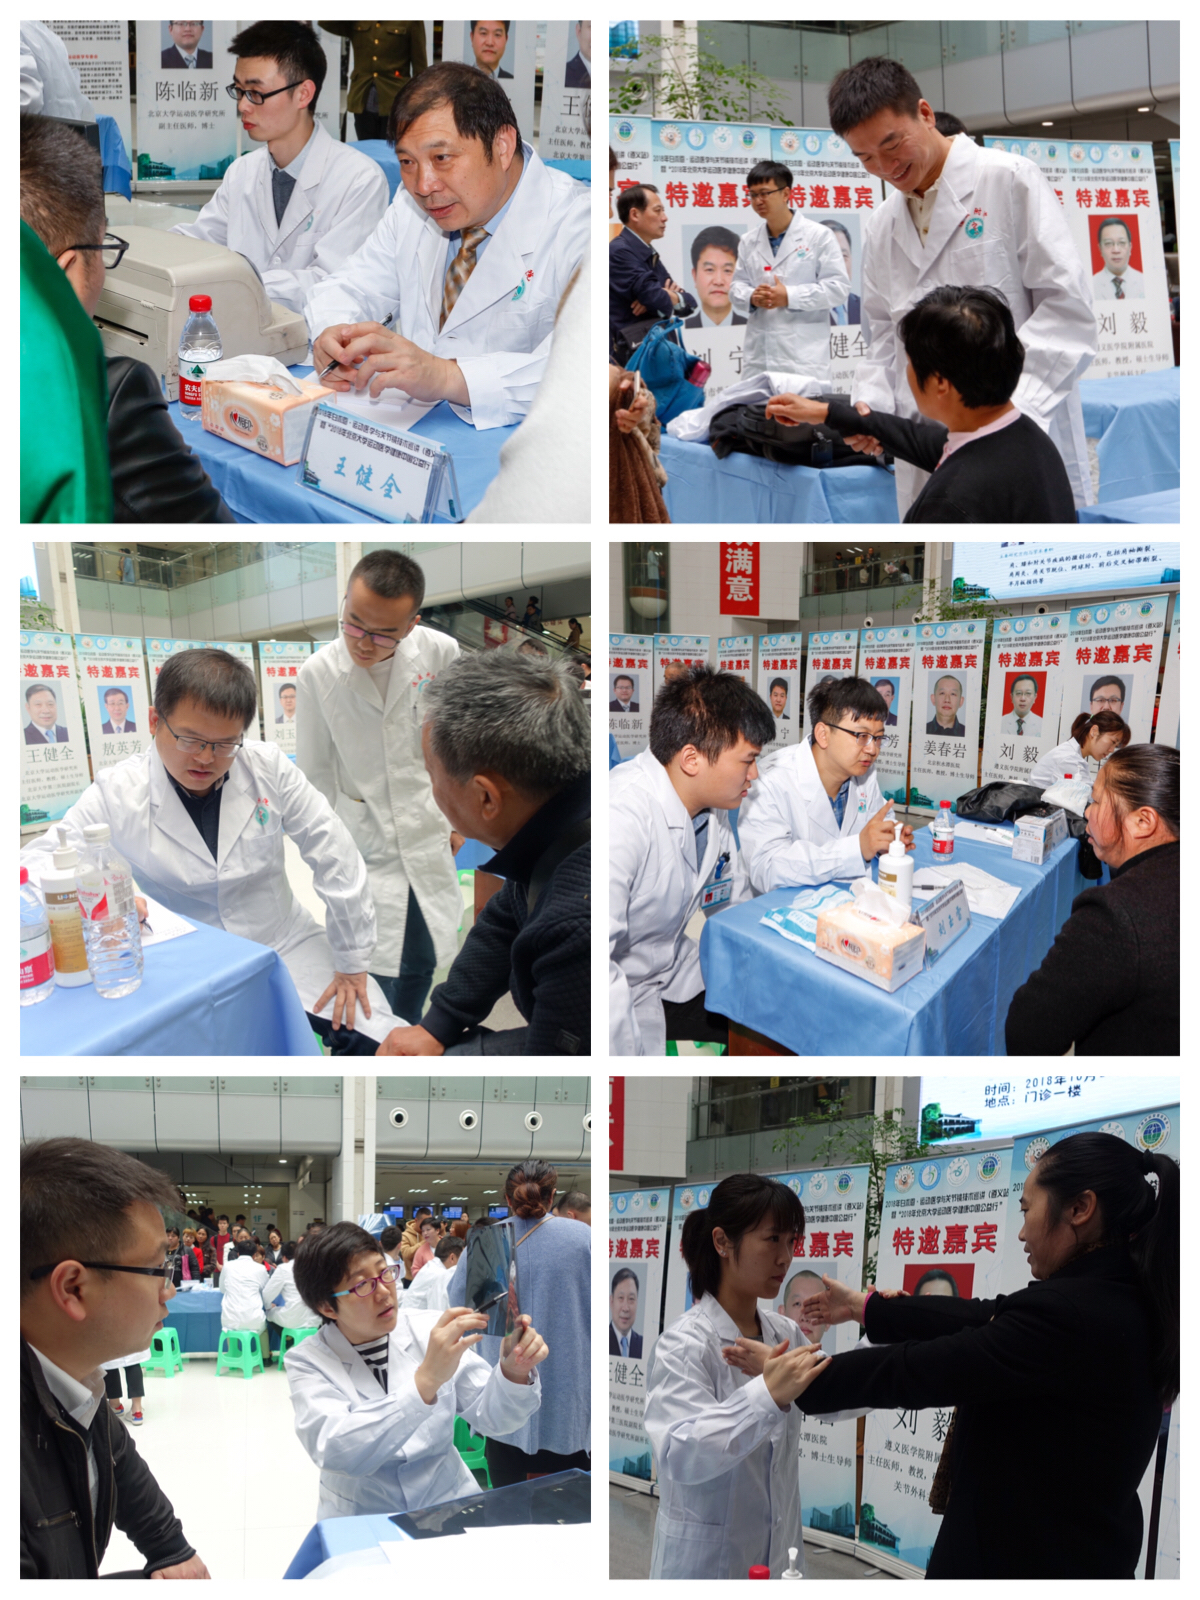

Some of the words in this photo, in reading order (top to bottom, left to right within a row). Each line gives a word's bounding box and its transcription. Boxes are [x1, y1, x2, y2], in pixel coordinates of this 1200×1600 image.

[155, 80, 220, 103] 陈临新
[148, 110, 226, 119] 北京大学运动医学研究所
[158, 122, 216, 131] 副主任医师，博士
[789, 184, 875, 209] 特邀嘉宾
[1076, 188, 1151, 208] 特邀嘉宾
[1098, 311, 1149, 336] 刘毅
[333, 456, 403, 500] 王健全
[609, 657, 648, 669] 邀嘉宾
[865, 656, 911, 670] 特邀嘉宾
[922, 653, 978, 669] 特邀嘉宾
[998, 650, 1060, 668] 特邀嘉宾
[1075, 643, 1154, 665] 特邀嘉宾
[20, 663, 70, 678] 邀嘉宾
[87, 665, 140, 679] 特邀嘉宾
[763, 658, 798, 671] 特邀嘉宾
[812, 657, 853, 671] 特邀嘉宾
[26, 746, 75, 764] 王健全
[102, 740, 142, 757] 敖英芳
[923, 740, 968, 760] 姜春岩
[999, 743, 1039, 764] 刘毅
[984, 1082, 1016, 1096] 时间：
[984, 1095, 1016, 1109] 地点：
[1024, 1084, 1082, 1104] 门诊一楼
[892, 1221, 999, 1256] 特邀嘉宾
[609, 1416, 644, 1431] 第三医院副院长
[867, 1454, 936, 1481] 主任医师，教授，
